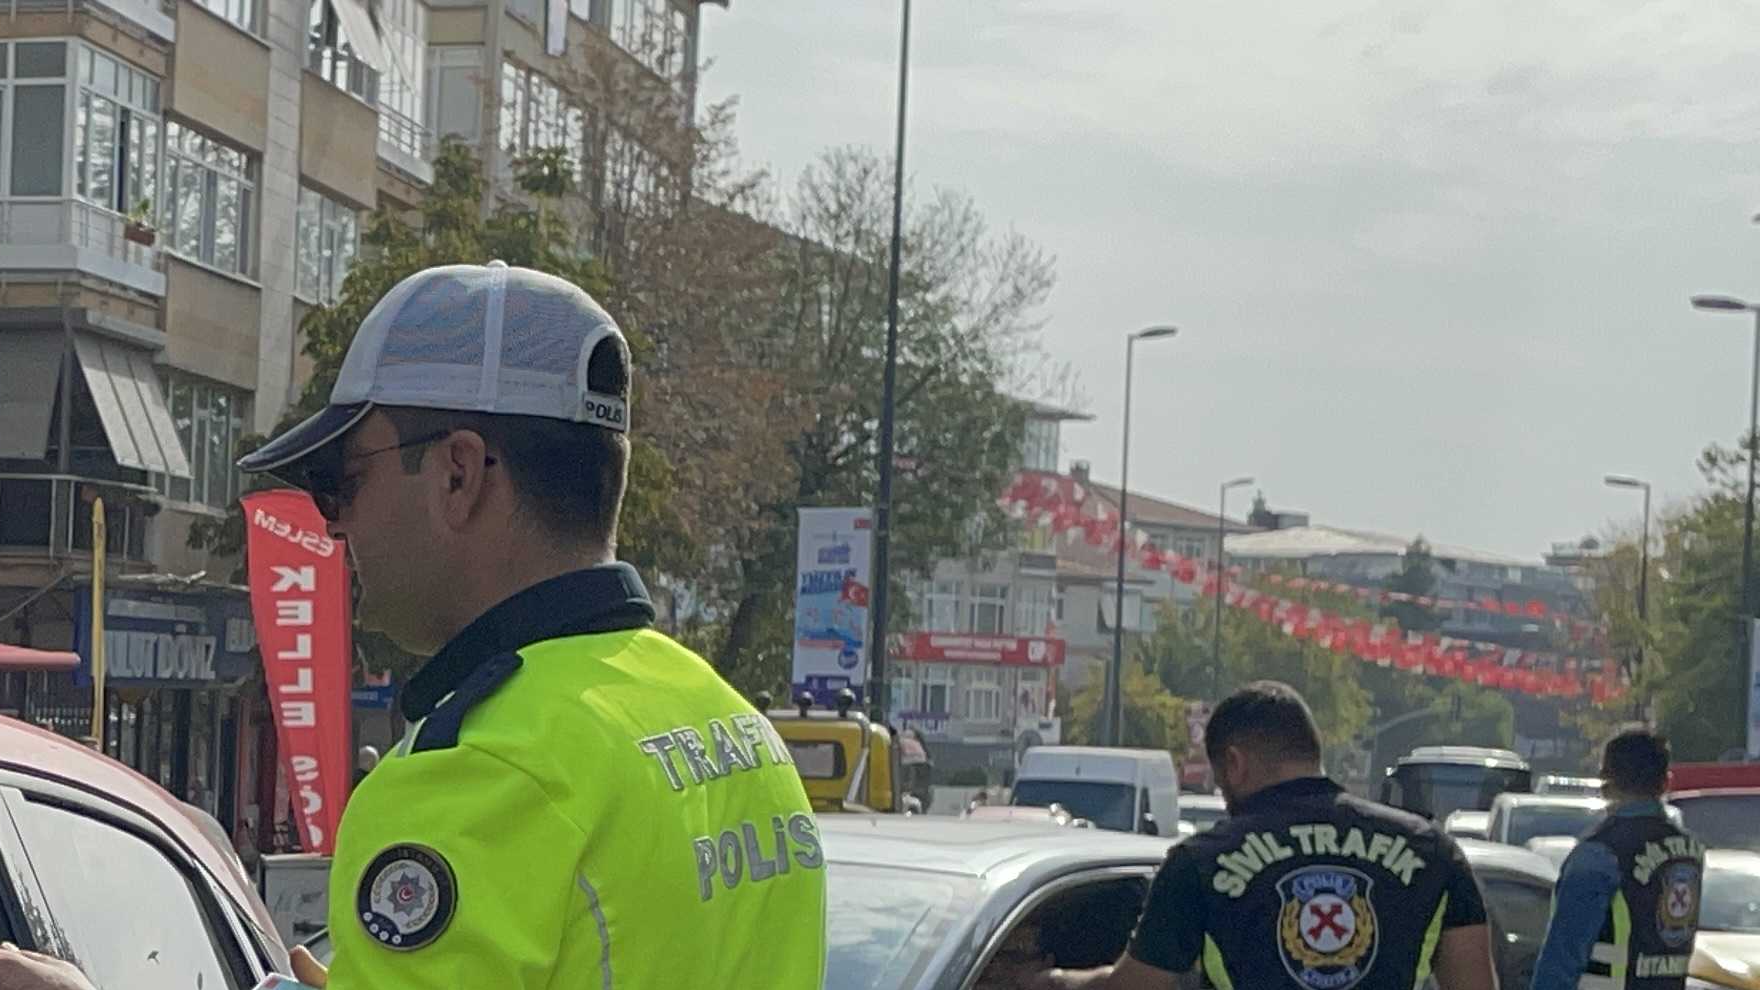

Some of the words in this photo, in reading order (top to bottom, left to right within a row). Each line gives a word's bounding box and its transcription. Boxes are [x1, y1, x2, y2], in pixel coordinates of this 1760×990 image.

[693, 812, 824, 902] POLİS
[1212, 831, 1293, 898] SİVİL
[1289, 823, 1426, 886] TRAFİK
